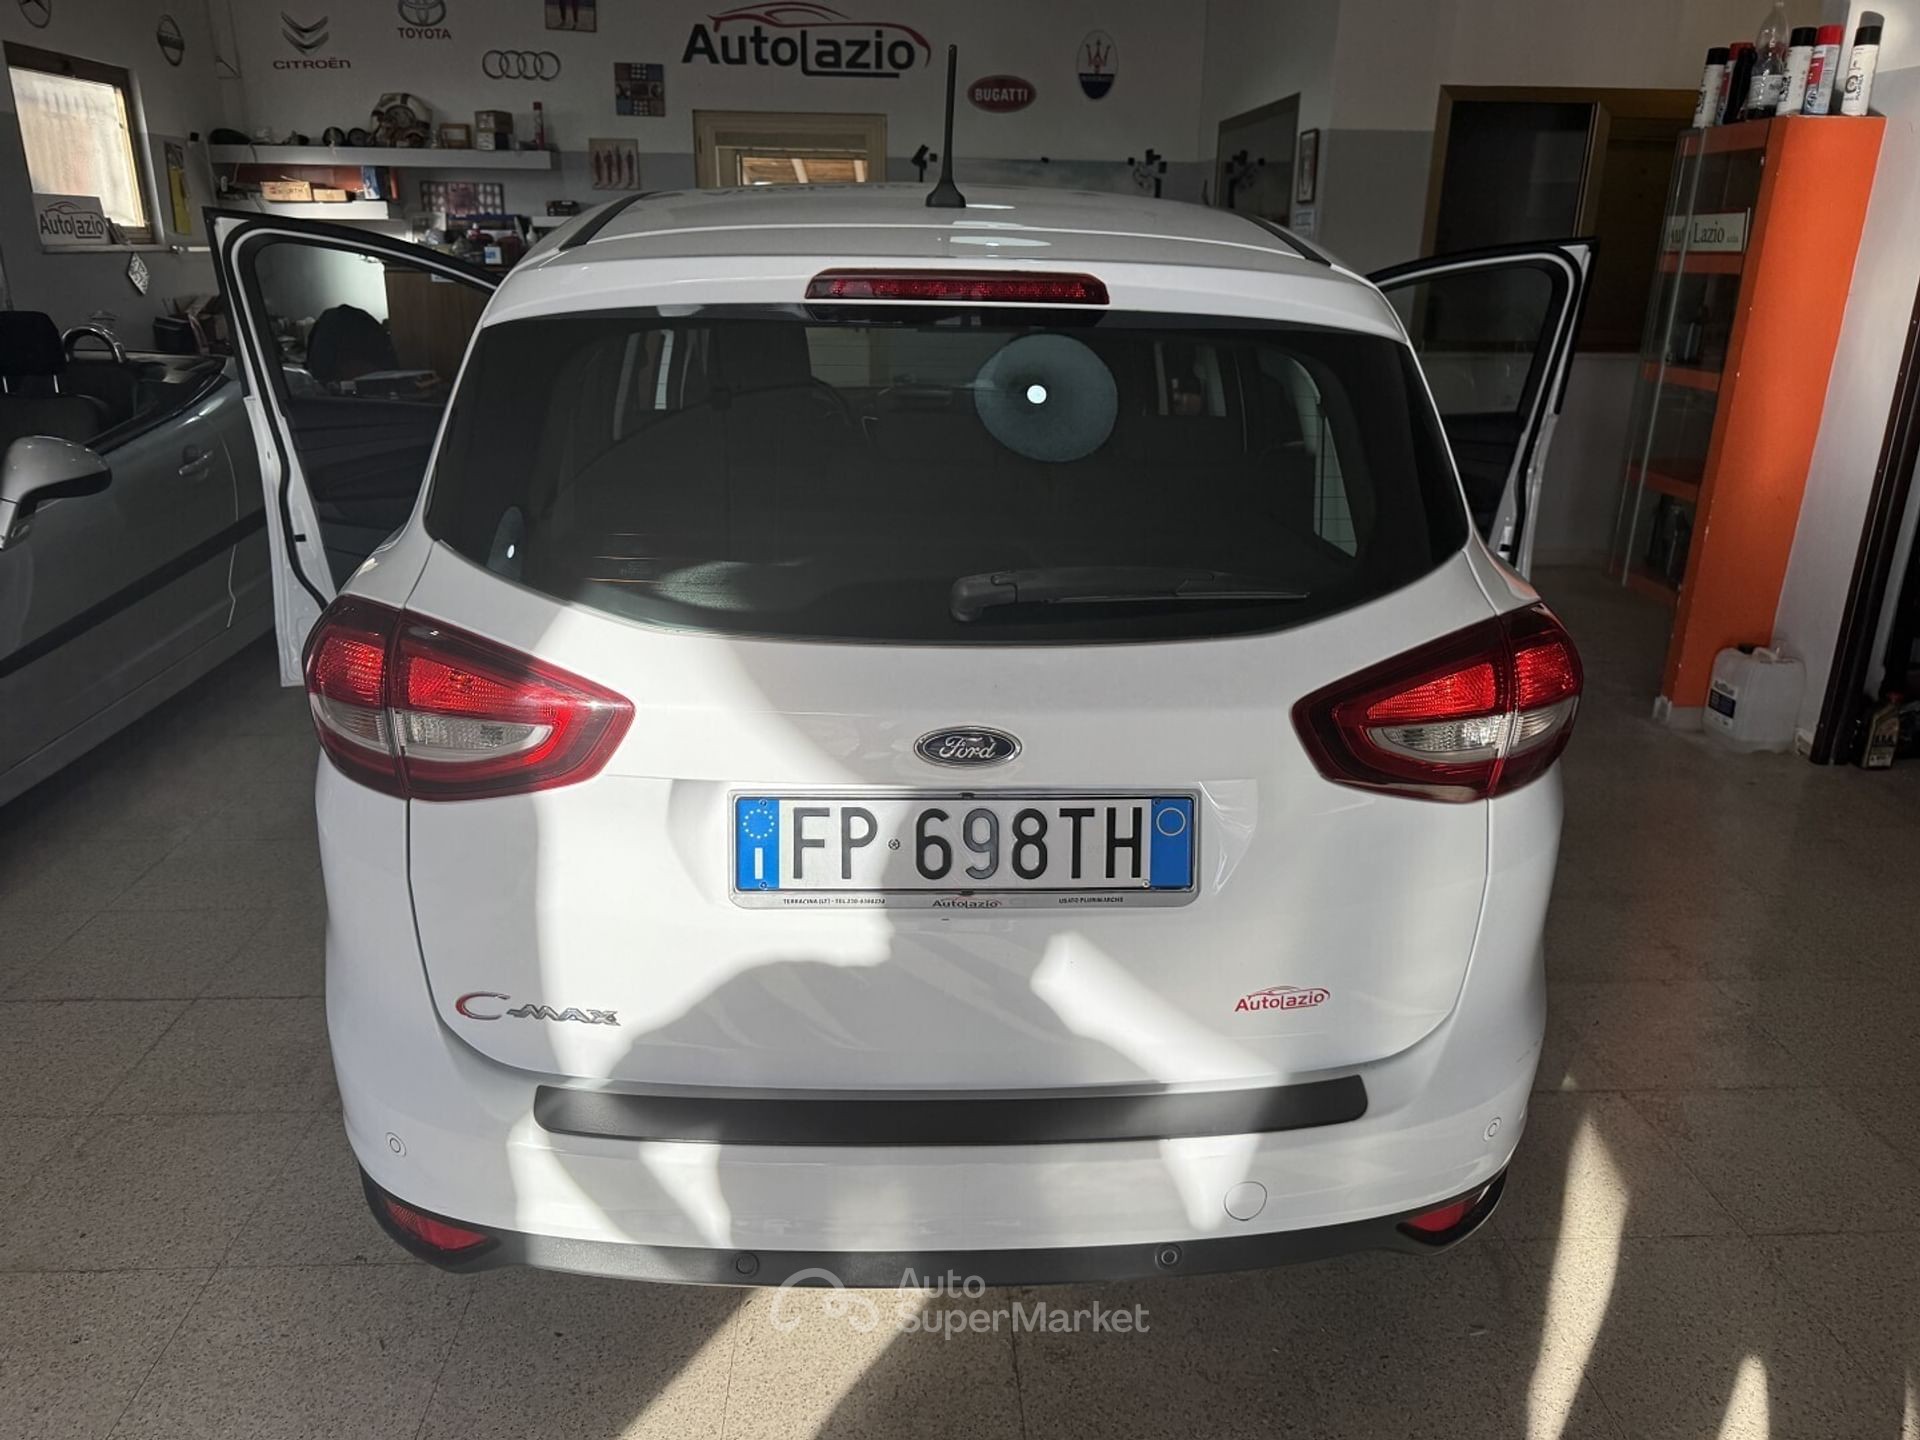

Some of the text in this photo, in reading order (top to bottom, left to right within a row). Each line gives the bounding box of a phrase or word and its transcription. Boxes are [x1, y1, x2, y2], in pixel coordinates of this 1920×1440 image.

[397, 27, 452, 40] TOYOTA
[974, 87, 1029, 102] BUGATTI
[1694, 220, 1725, 243] Lazio
[939, 735, 996, 759] Ford
[793, 807, 1142, 880] FP 698TH
